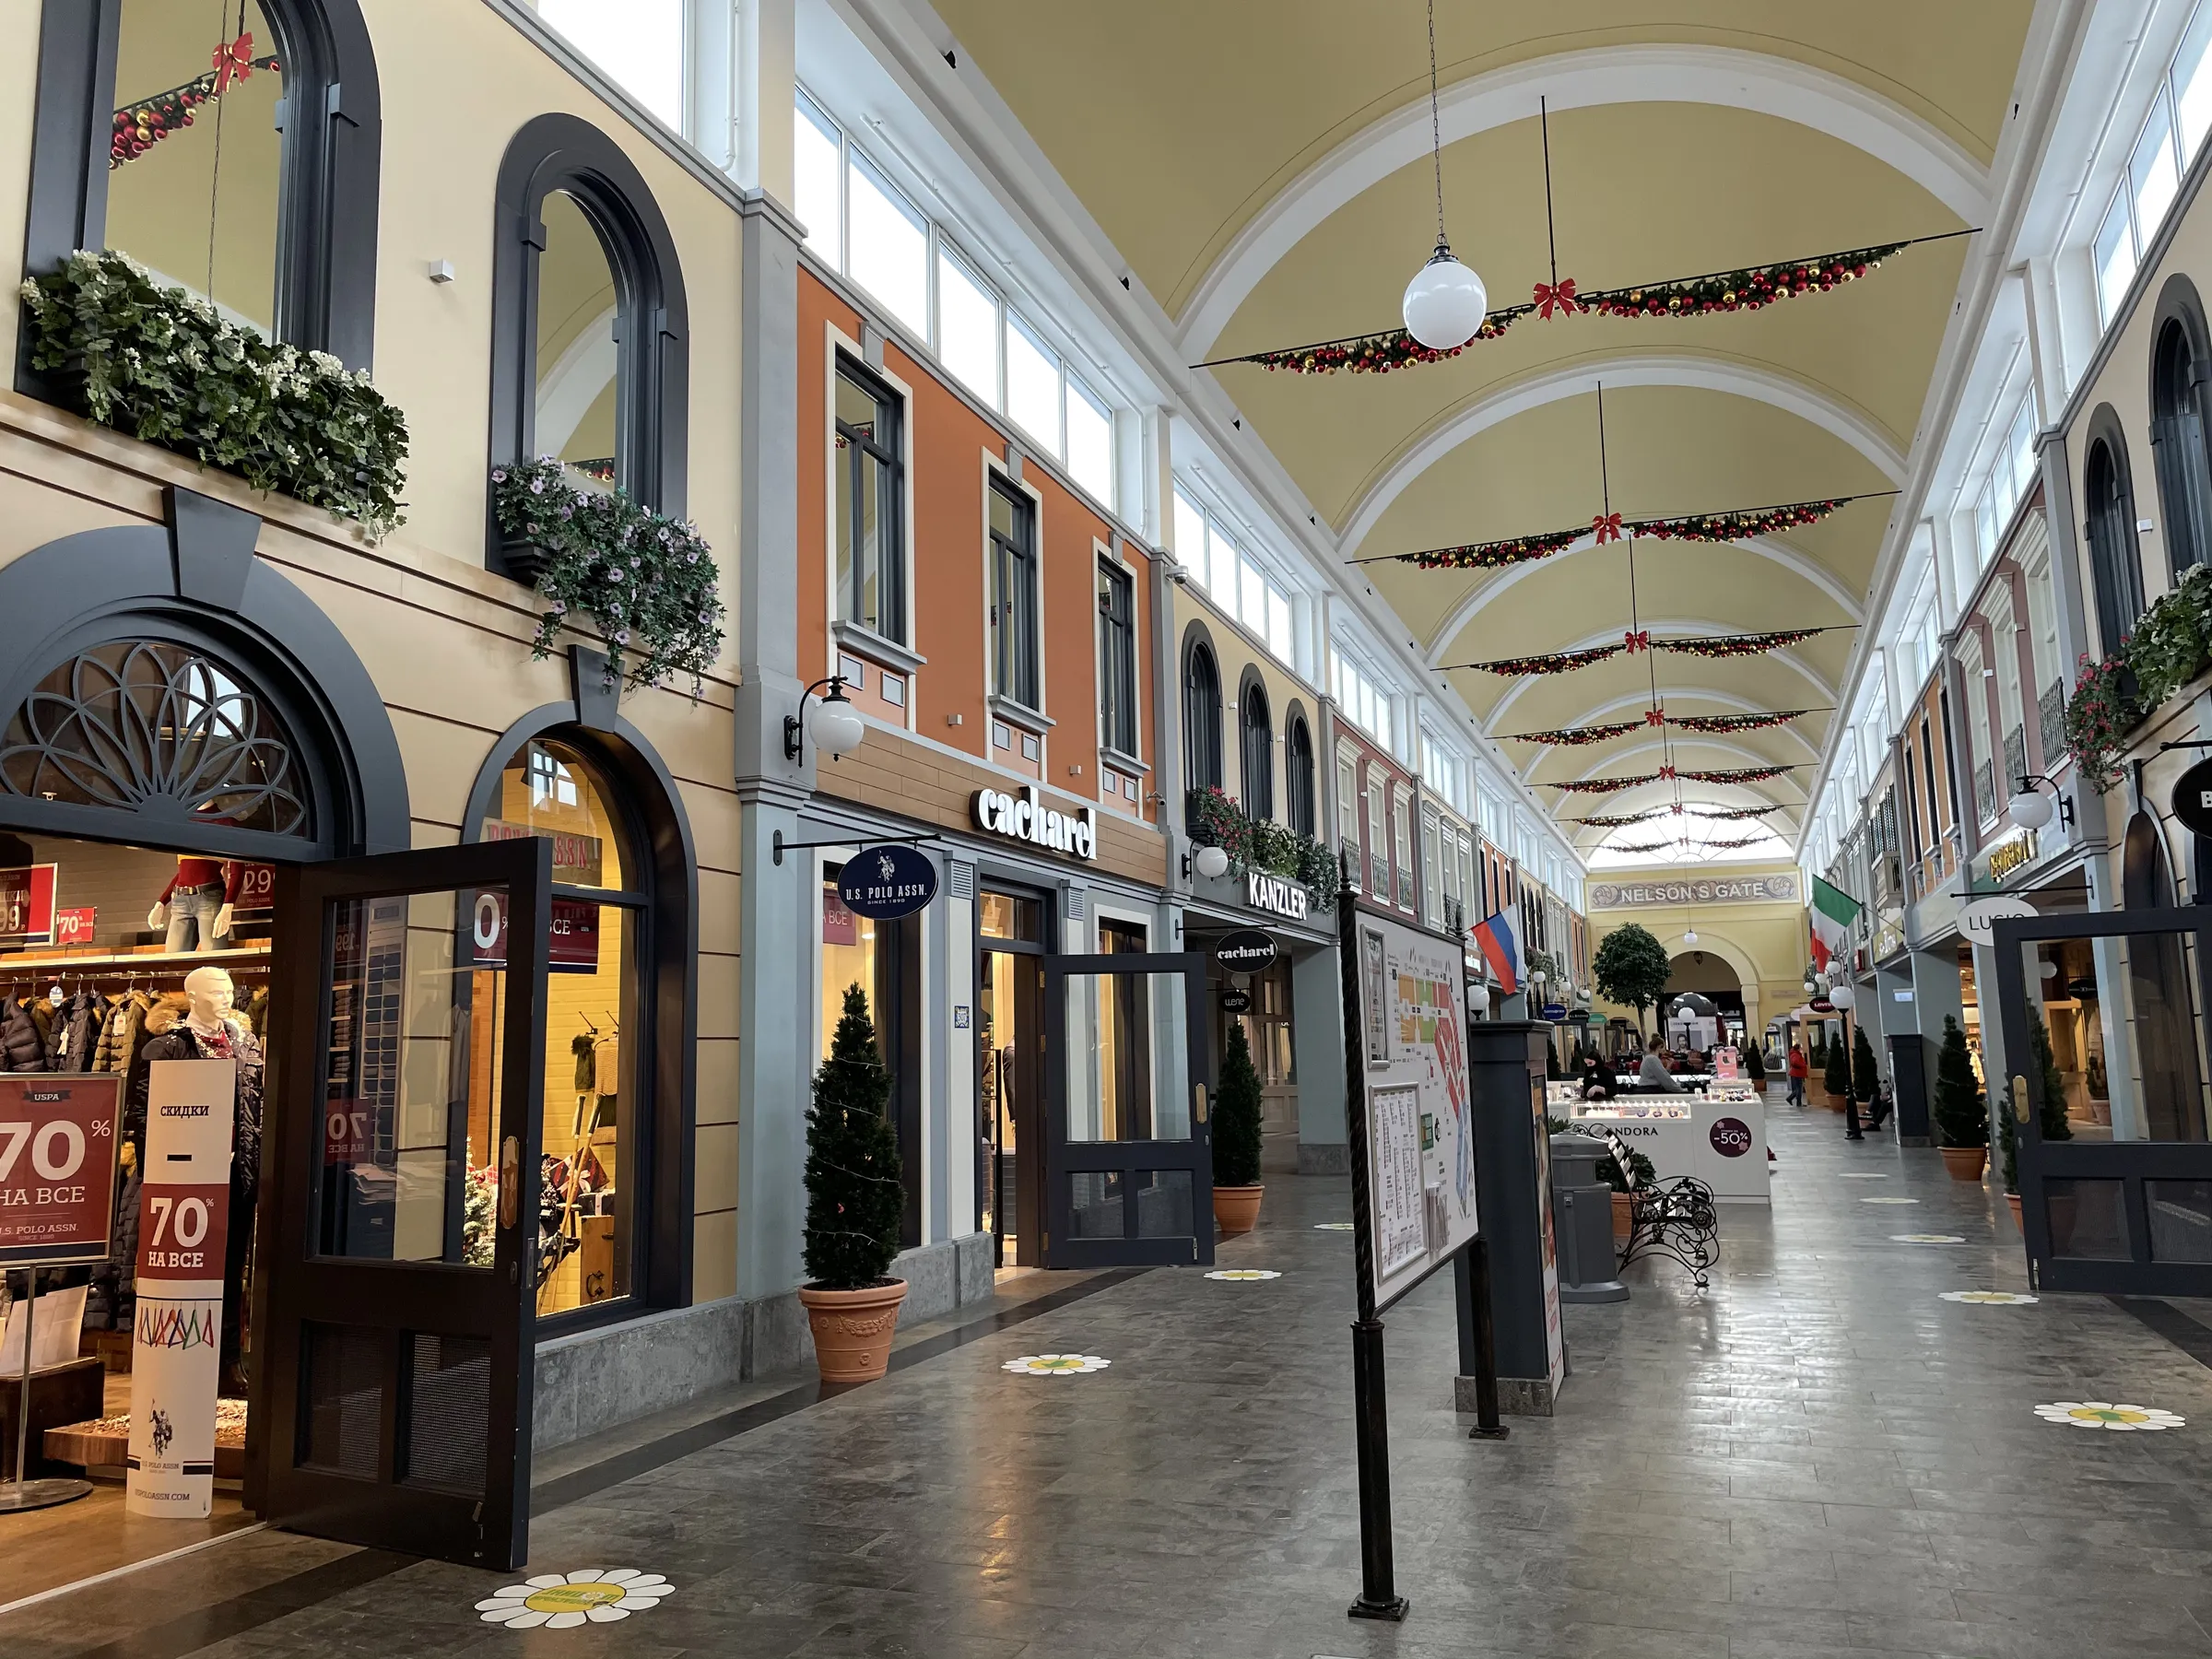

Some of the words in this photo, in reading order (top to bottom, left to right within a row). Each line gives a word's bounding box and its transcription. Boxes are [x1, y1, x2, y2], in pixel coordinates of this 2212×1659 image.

[971, 785, 1098, 860] cacharel
[242, 869, 276, 895] 29
[1715, 882, 1765, 899] GATE
[845, 888, 864, 900] U.S.
[867, 887, 893, 900] POLO
[898, 883, 927, 898] ASSN.
[1249, 871, 1307, 921] KANZLER
[829, 910, 848, 925] ВСЕ
[549, 918, 571, 935] СЕ
[1218, 944, 1275, 959] cacharel
[160, 1106, 209, 1118] СКИДКИ
[1611, 1126, 1659, 1137] NDORA
[35, 1186, 86, 1205] ВСЕ
[17, 1225, 46, 1234] POLO
[47, 1223, 79, 1232] ASSN.
[148, 1252, 166, 1267] НА
[168, 1252, 204, 1268] ВСЕ
